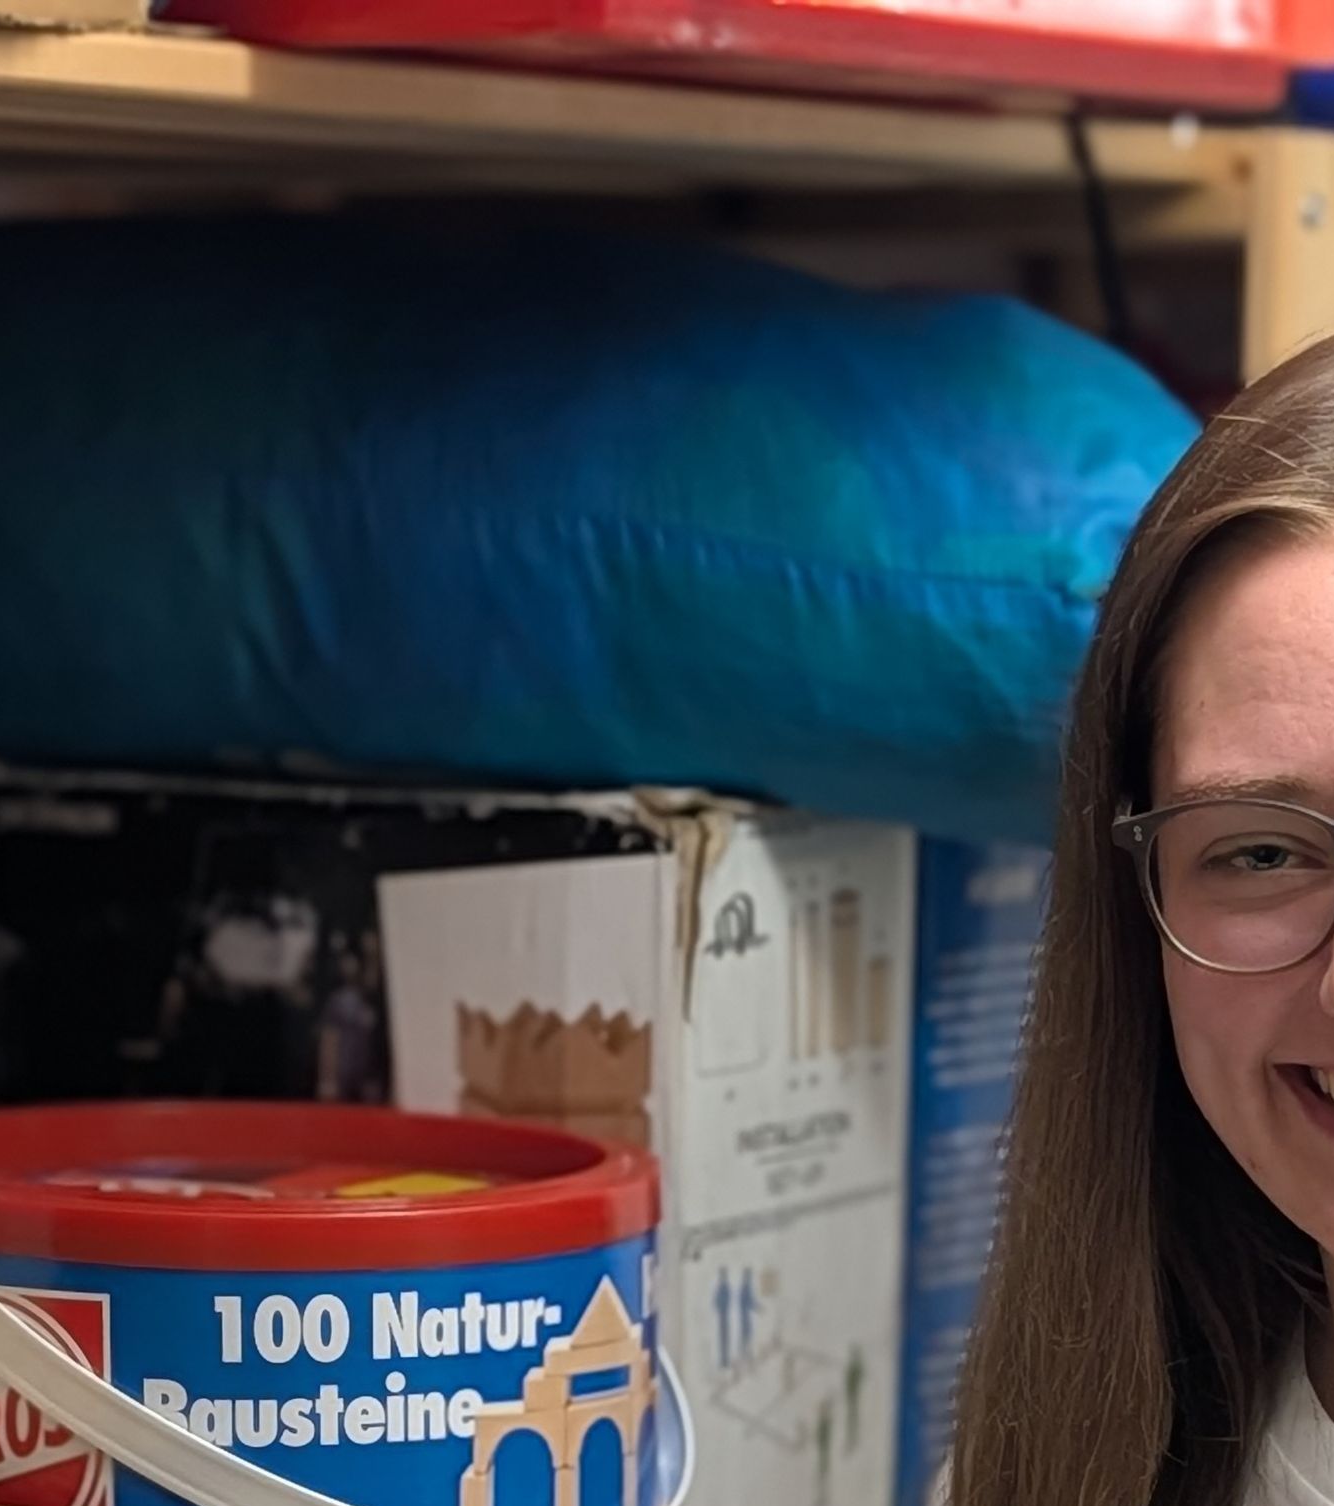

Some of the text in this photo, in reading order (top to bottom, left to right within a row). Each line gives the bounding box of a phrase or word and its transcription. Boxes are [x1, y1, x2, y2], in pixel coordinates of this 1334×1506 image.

[214, 1291, 562, 1363] 100 Natur-
[143, 1371, 484, 1449] Bausteine
